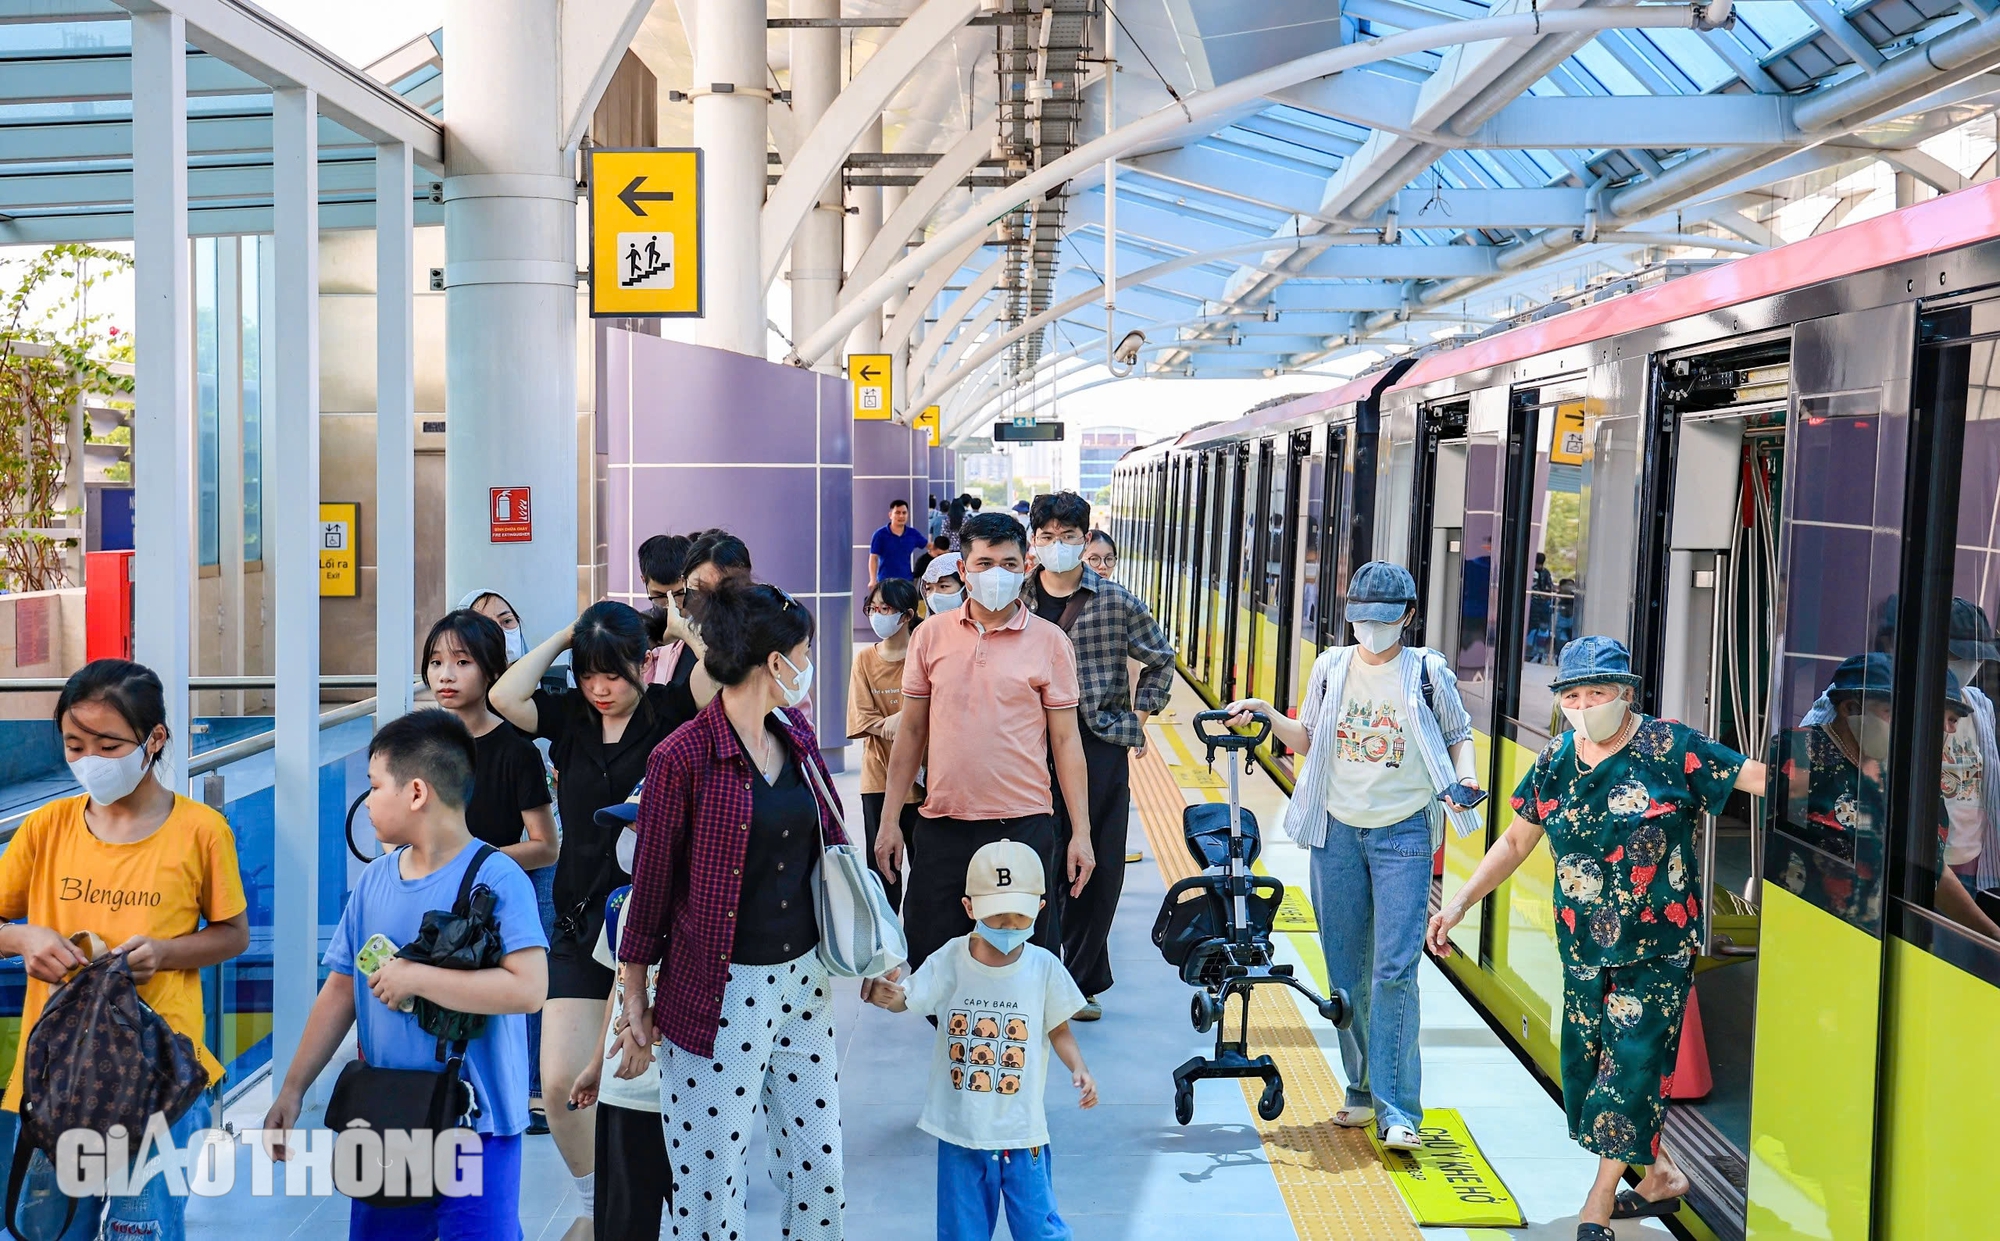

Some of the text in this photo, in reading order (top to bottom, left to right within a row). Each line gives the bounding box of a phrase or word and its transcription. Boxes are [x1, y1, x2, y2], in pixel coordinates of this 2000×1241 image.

[338, 561, 348, 569] ra
[327, 572, 340, 580] Exit
[995, 867, 1012, 887] B
[59, 877, 161, 912] Blengano
[963, 998, 1019, 1009] CAPY BARA
[1417, 1127, 1508, 1205] CHÚ Ý KHE HỞ
